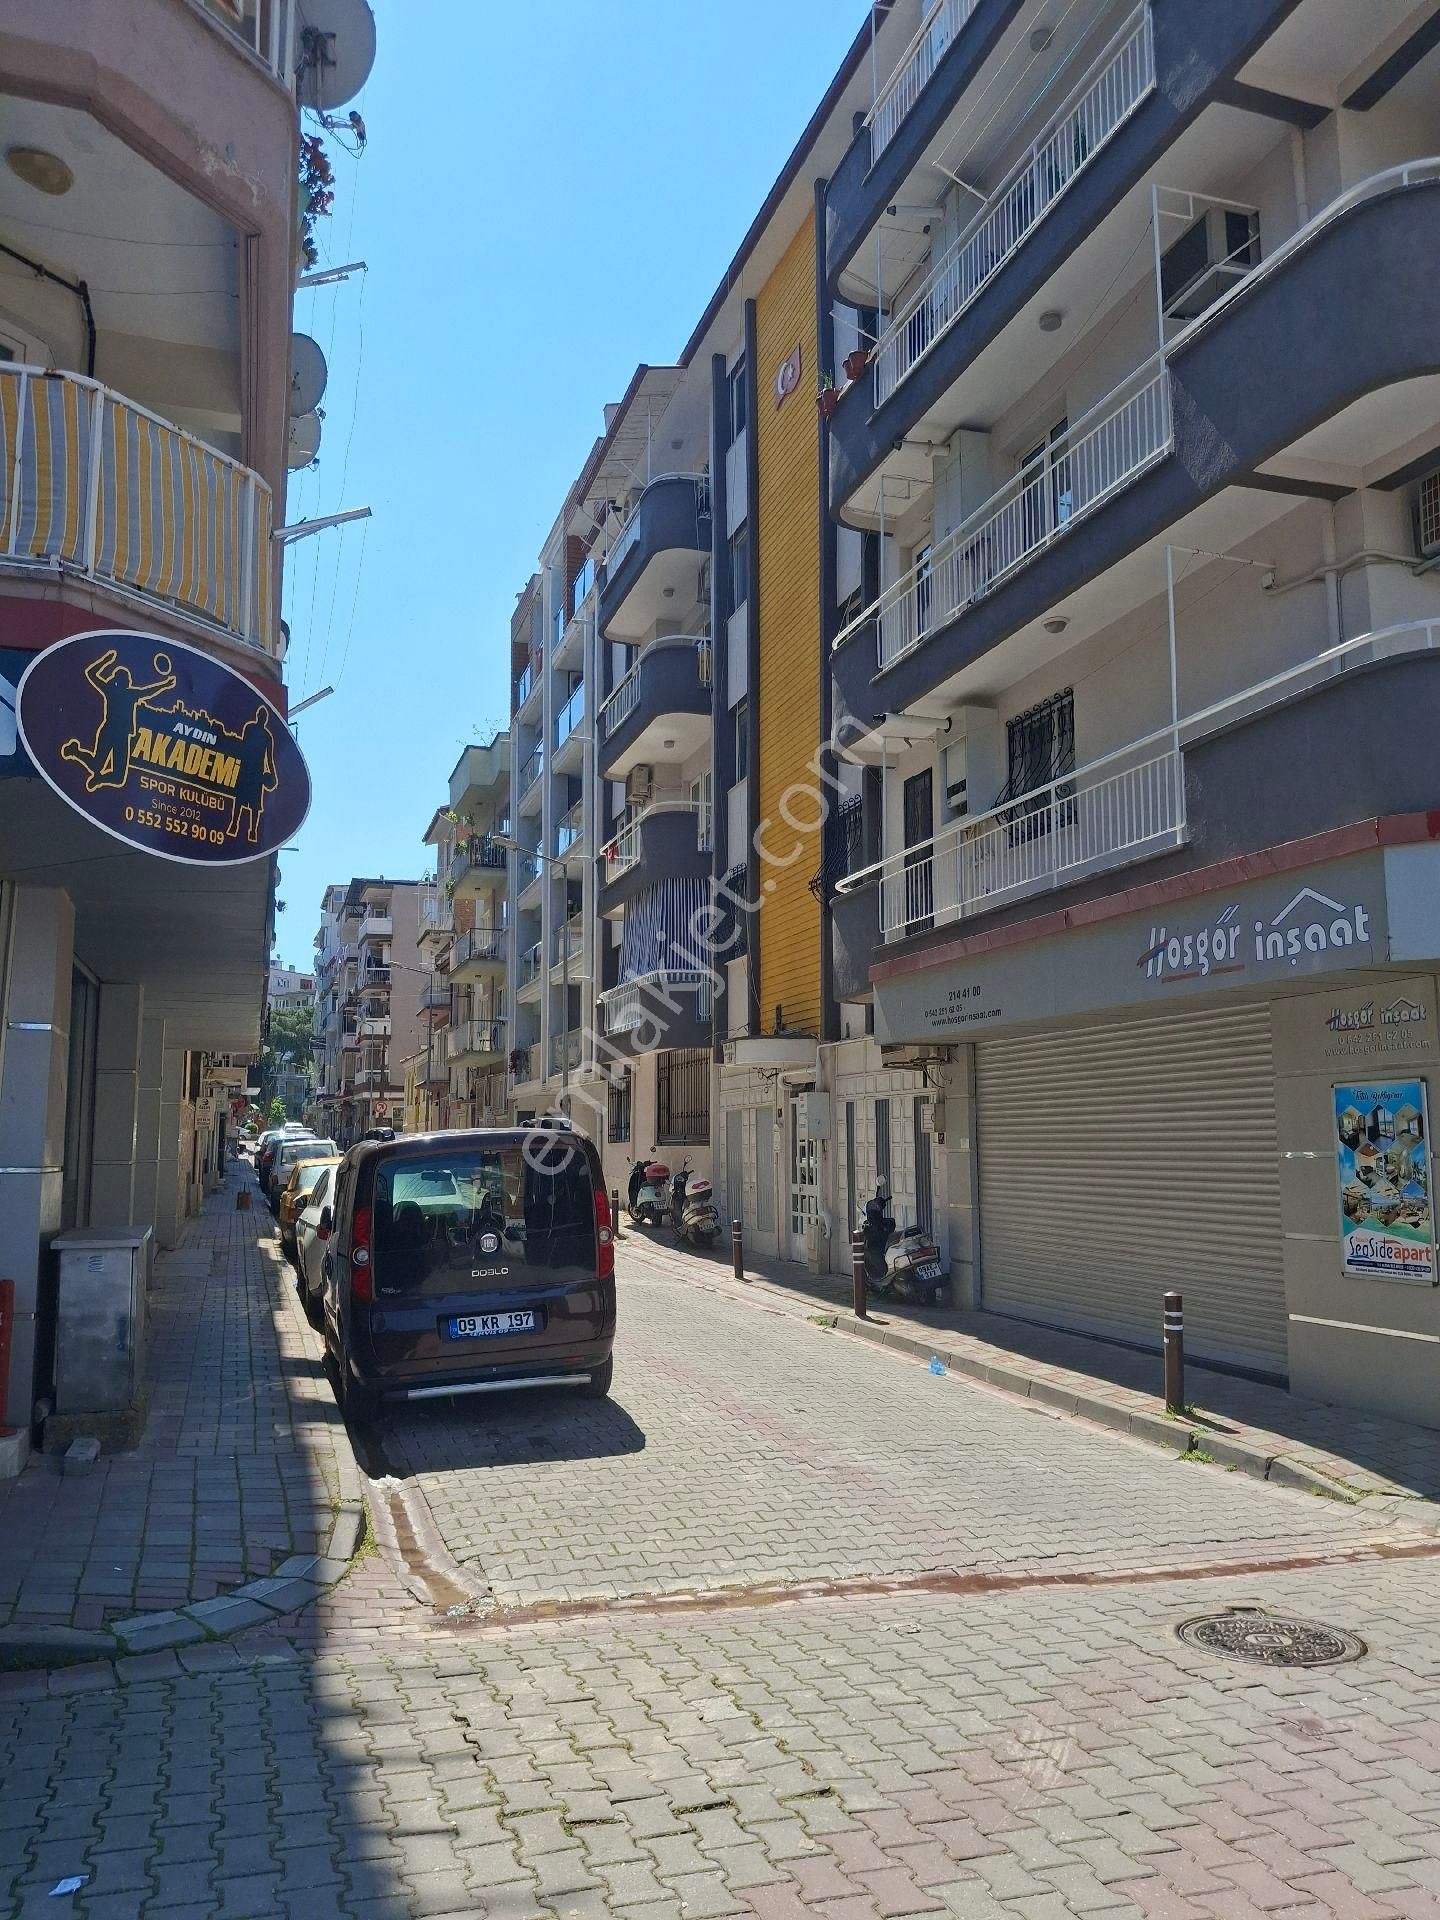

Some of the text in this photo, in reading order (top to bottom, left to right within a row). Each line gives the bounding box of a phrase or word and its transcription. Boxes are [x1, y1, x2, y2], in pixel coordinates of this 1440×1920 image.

[172, 722, 218, 746] AYDIN
[140, 776, 226, 812] SPOR KULÜBÜ
[151, 798, 201, 821] Since 2012
[125, 806, 225, 845] 0 552 552 90 09
[1253, 904, 1371, 966] inşaat
[948, 985, 981, 1001] 214 41 00
[458, 1319, 477, 1332] 09
[481, 1316, 499, 1330] KR
[508, 1312, 532, 1328] 197
